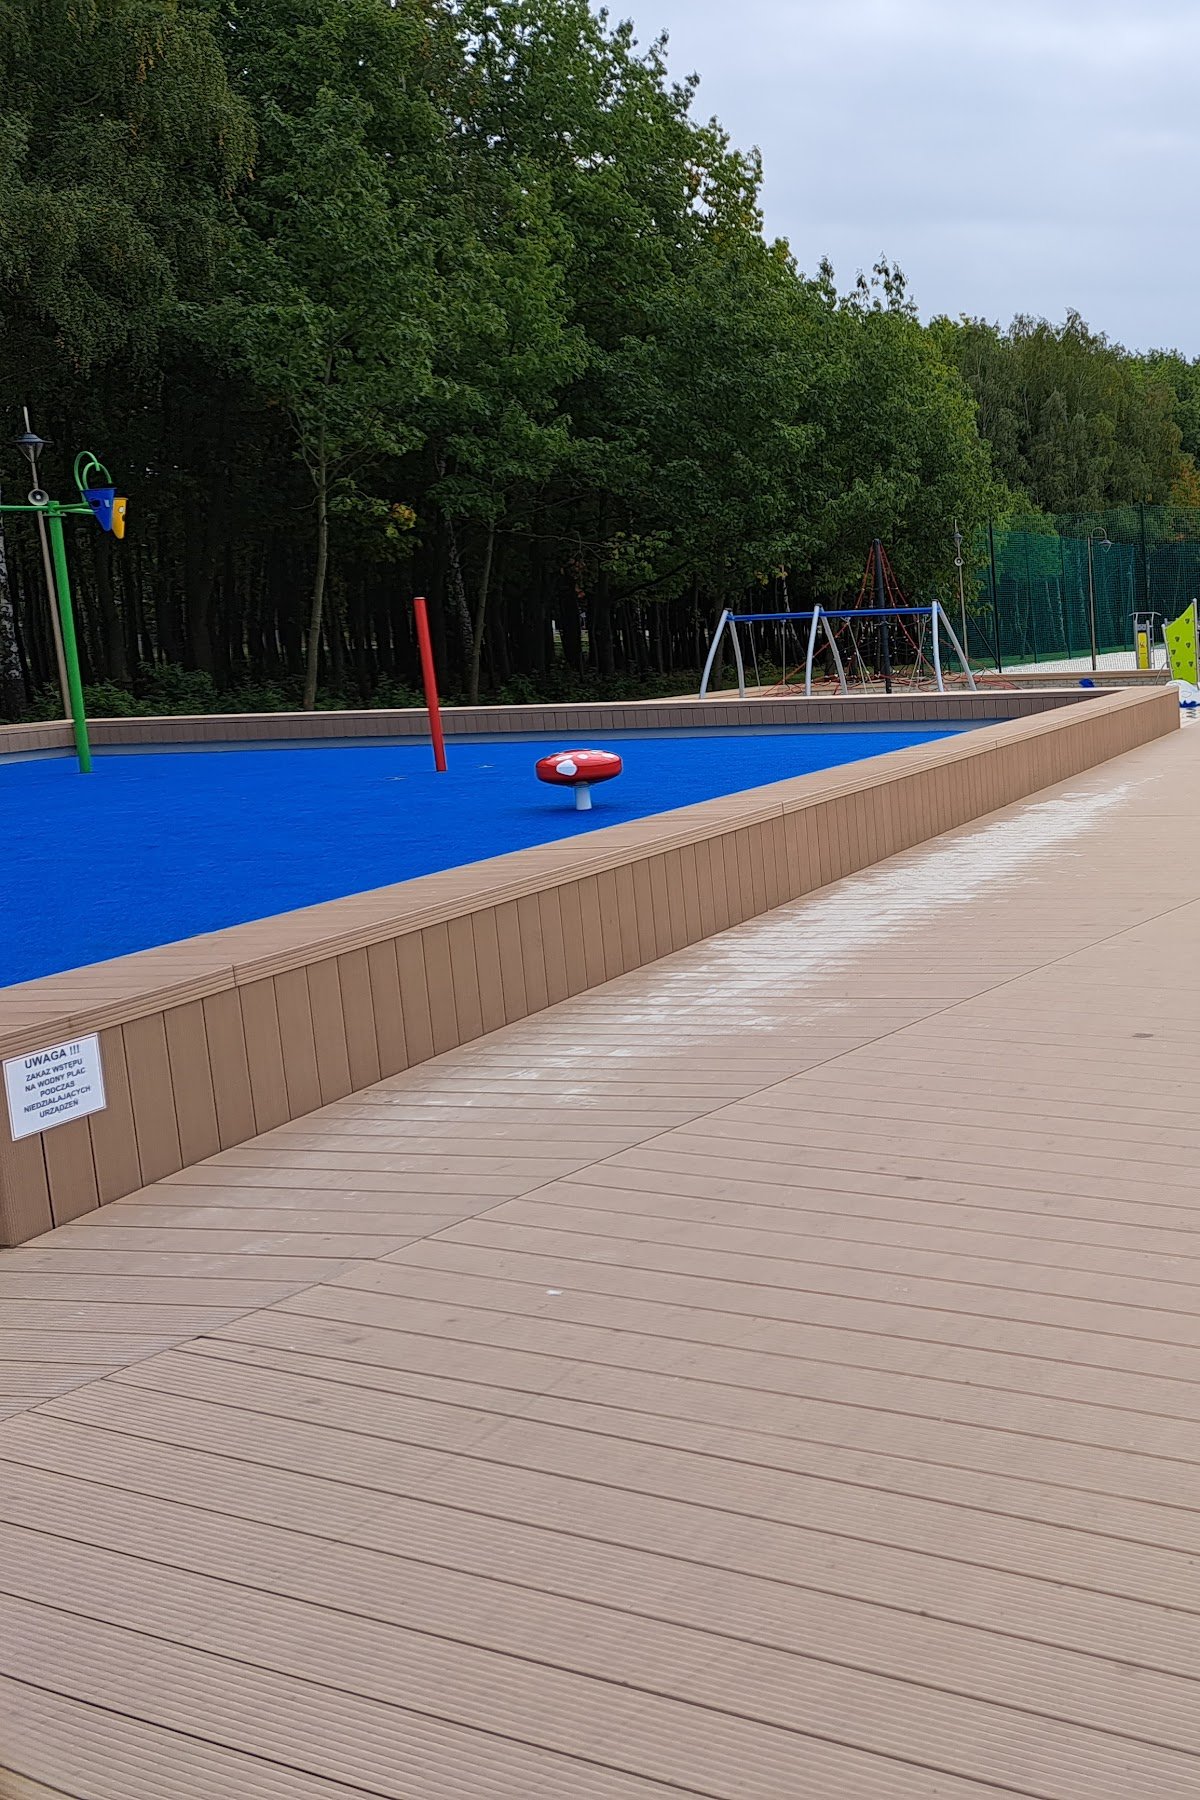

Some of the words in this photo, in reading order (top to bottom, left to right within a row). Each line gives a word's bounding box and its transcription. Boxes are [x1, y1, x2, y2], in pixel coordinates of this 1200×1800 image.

[24, 1048, 67, 1069] UWAGA
[70, 1044, 80, 1055] !!!
[25, 1084, 36, 1092] NA
[37, 1074, 65, 1088] WODNY
[66, 1067, 86, 1078] PLAC
[26, 1068, 51, 1082] ZAKAZ
[51, 1058, 83, 1074] WSTĘPU
[23, 1085, 91, 1113] NIEDZIAŁAJĄCYCH
[40, 1080, 75, 1097] PODCZAS
[39, 1099, 79, 1118] URZĄDZEŃ
